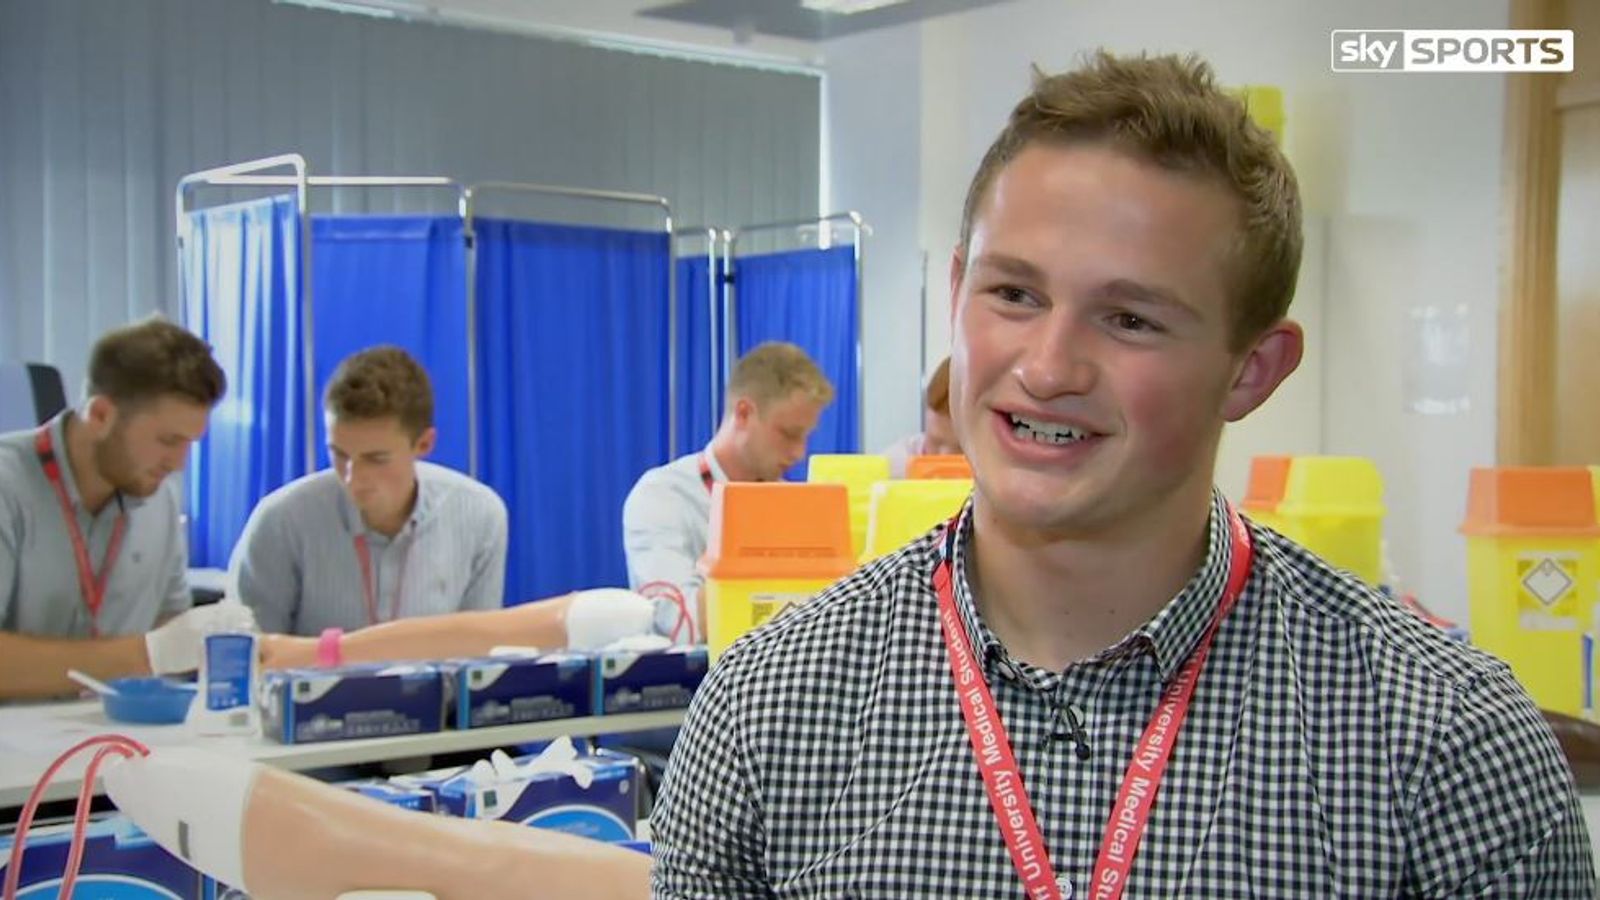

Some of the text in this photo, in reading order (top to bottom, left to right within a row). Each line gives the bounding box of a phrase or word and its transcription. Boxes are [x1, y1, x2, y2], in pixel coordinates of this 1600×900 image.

[943, 608, 975, 686] Student
[964, 686, 1003, 767] Medical
[1136, 668, 1194, 772] University
[992, 769, 1043, 881] University
[1106, 776, 1151, 863] Medical
